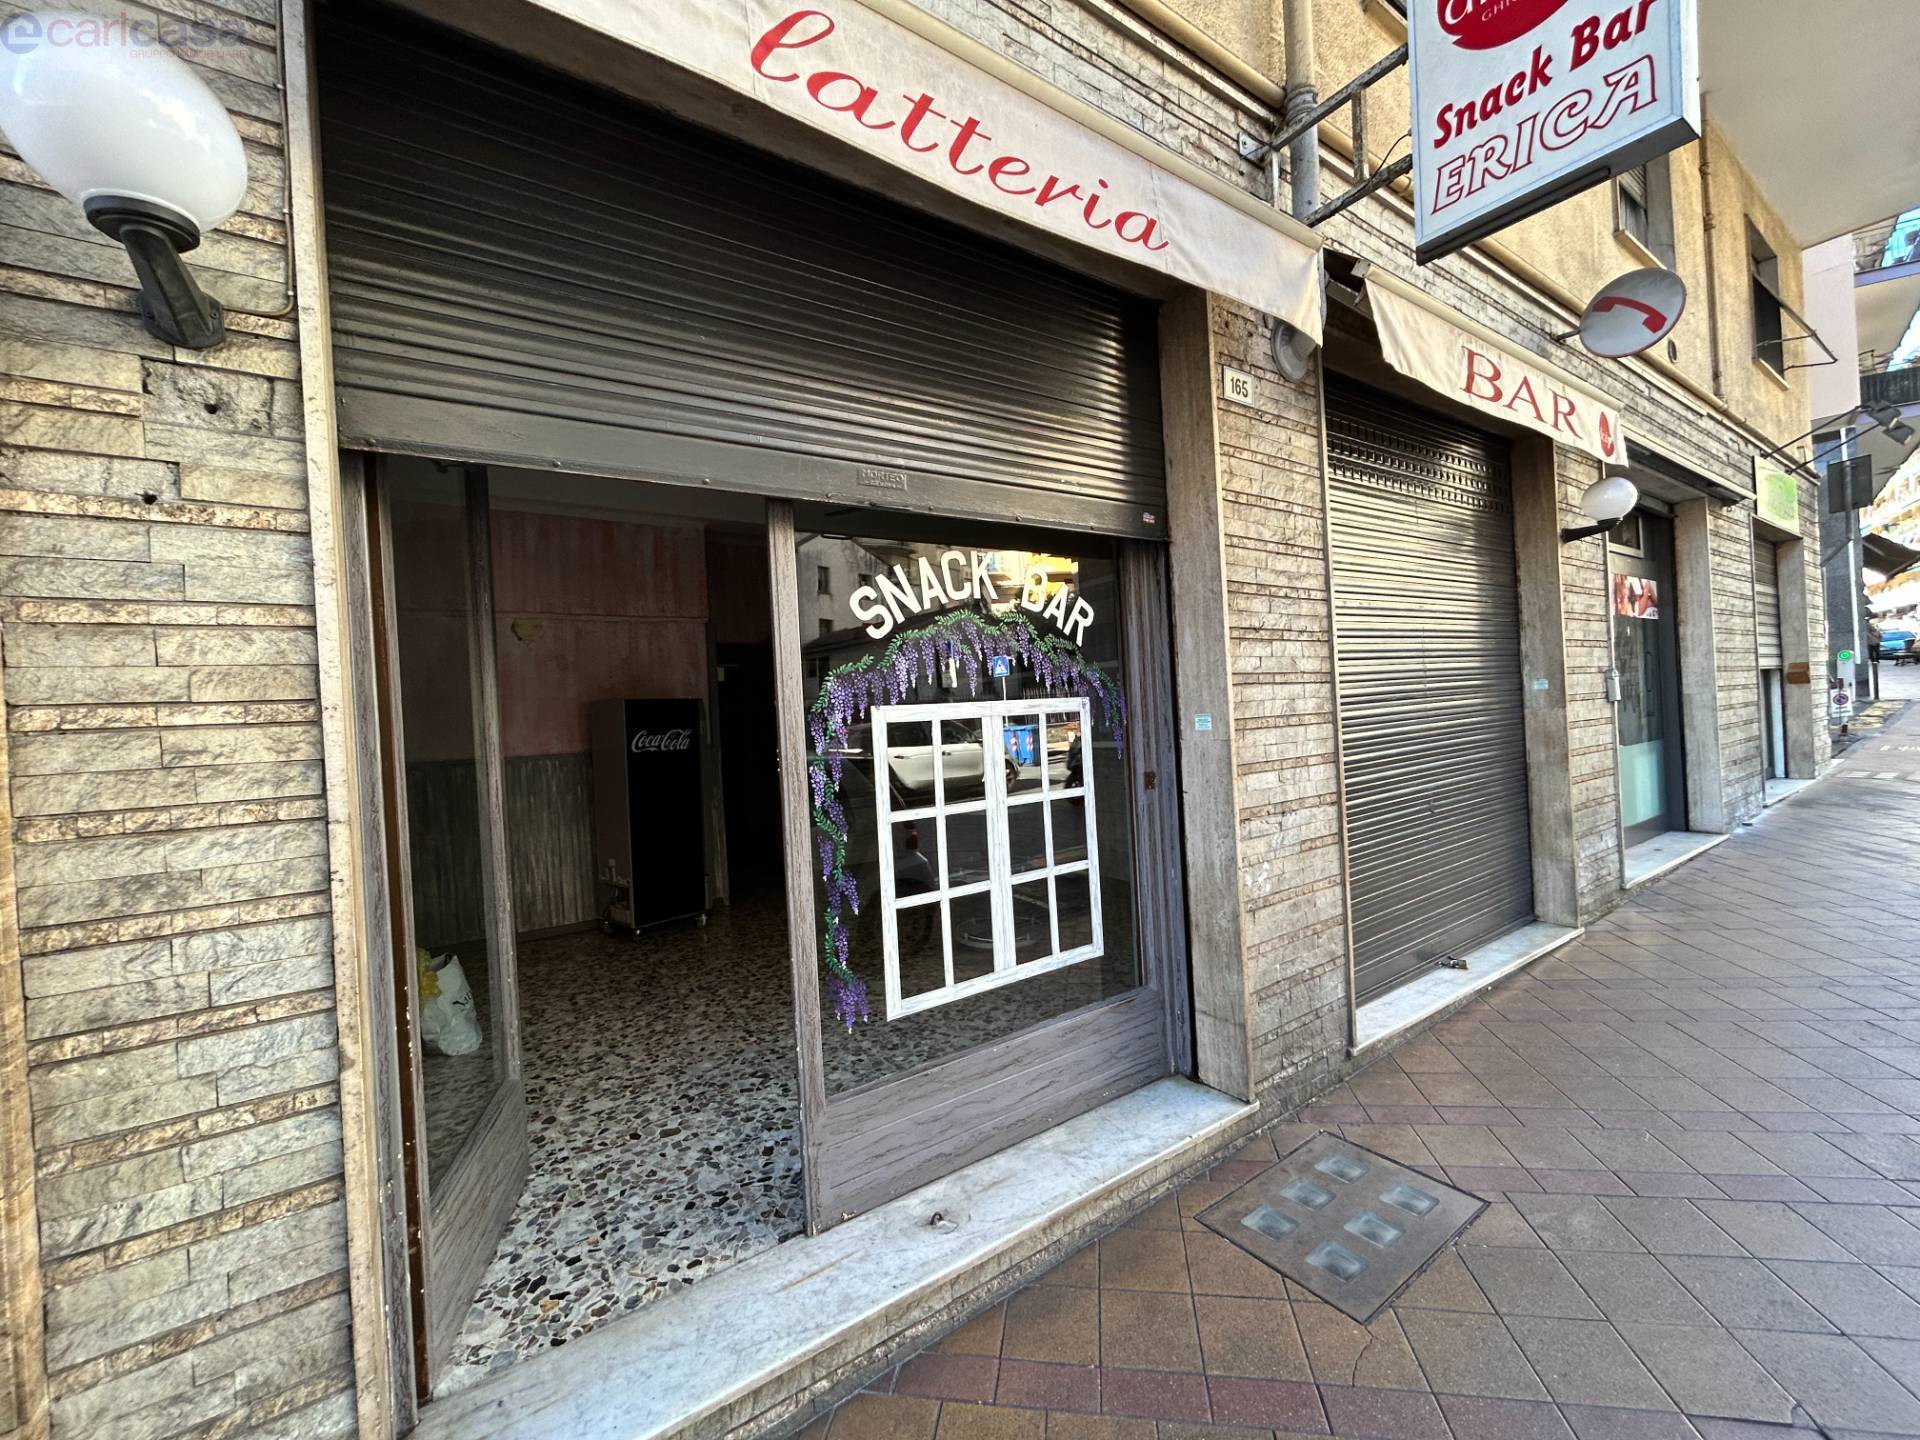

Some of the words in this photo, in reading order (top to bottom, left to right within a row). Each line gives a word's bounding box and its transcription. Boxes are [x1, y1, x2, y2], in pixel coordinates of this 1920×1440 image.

[1433, 45, 1553, 149] Snack
[1569, 0, 1658, 72] Bar
[1431, 54, 1658, 215] ERICA
[1230, 376, 1249, 398] 165
[1459, 345, 1583, 440] BAR
[849, 550, 998, 640] SNACK
[1020, 565, 1095, 647] BAR
